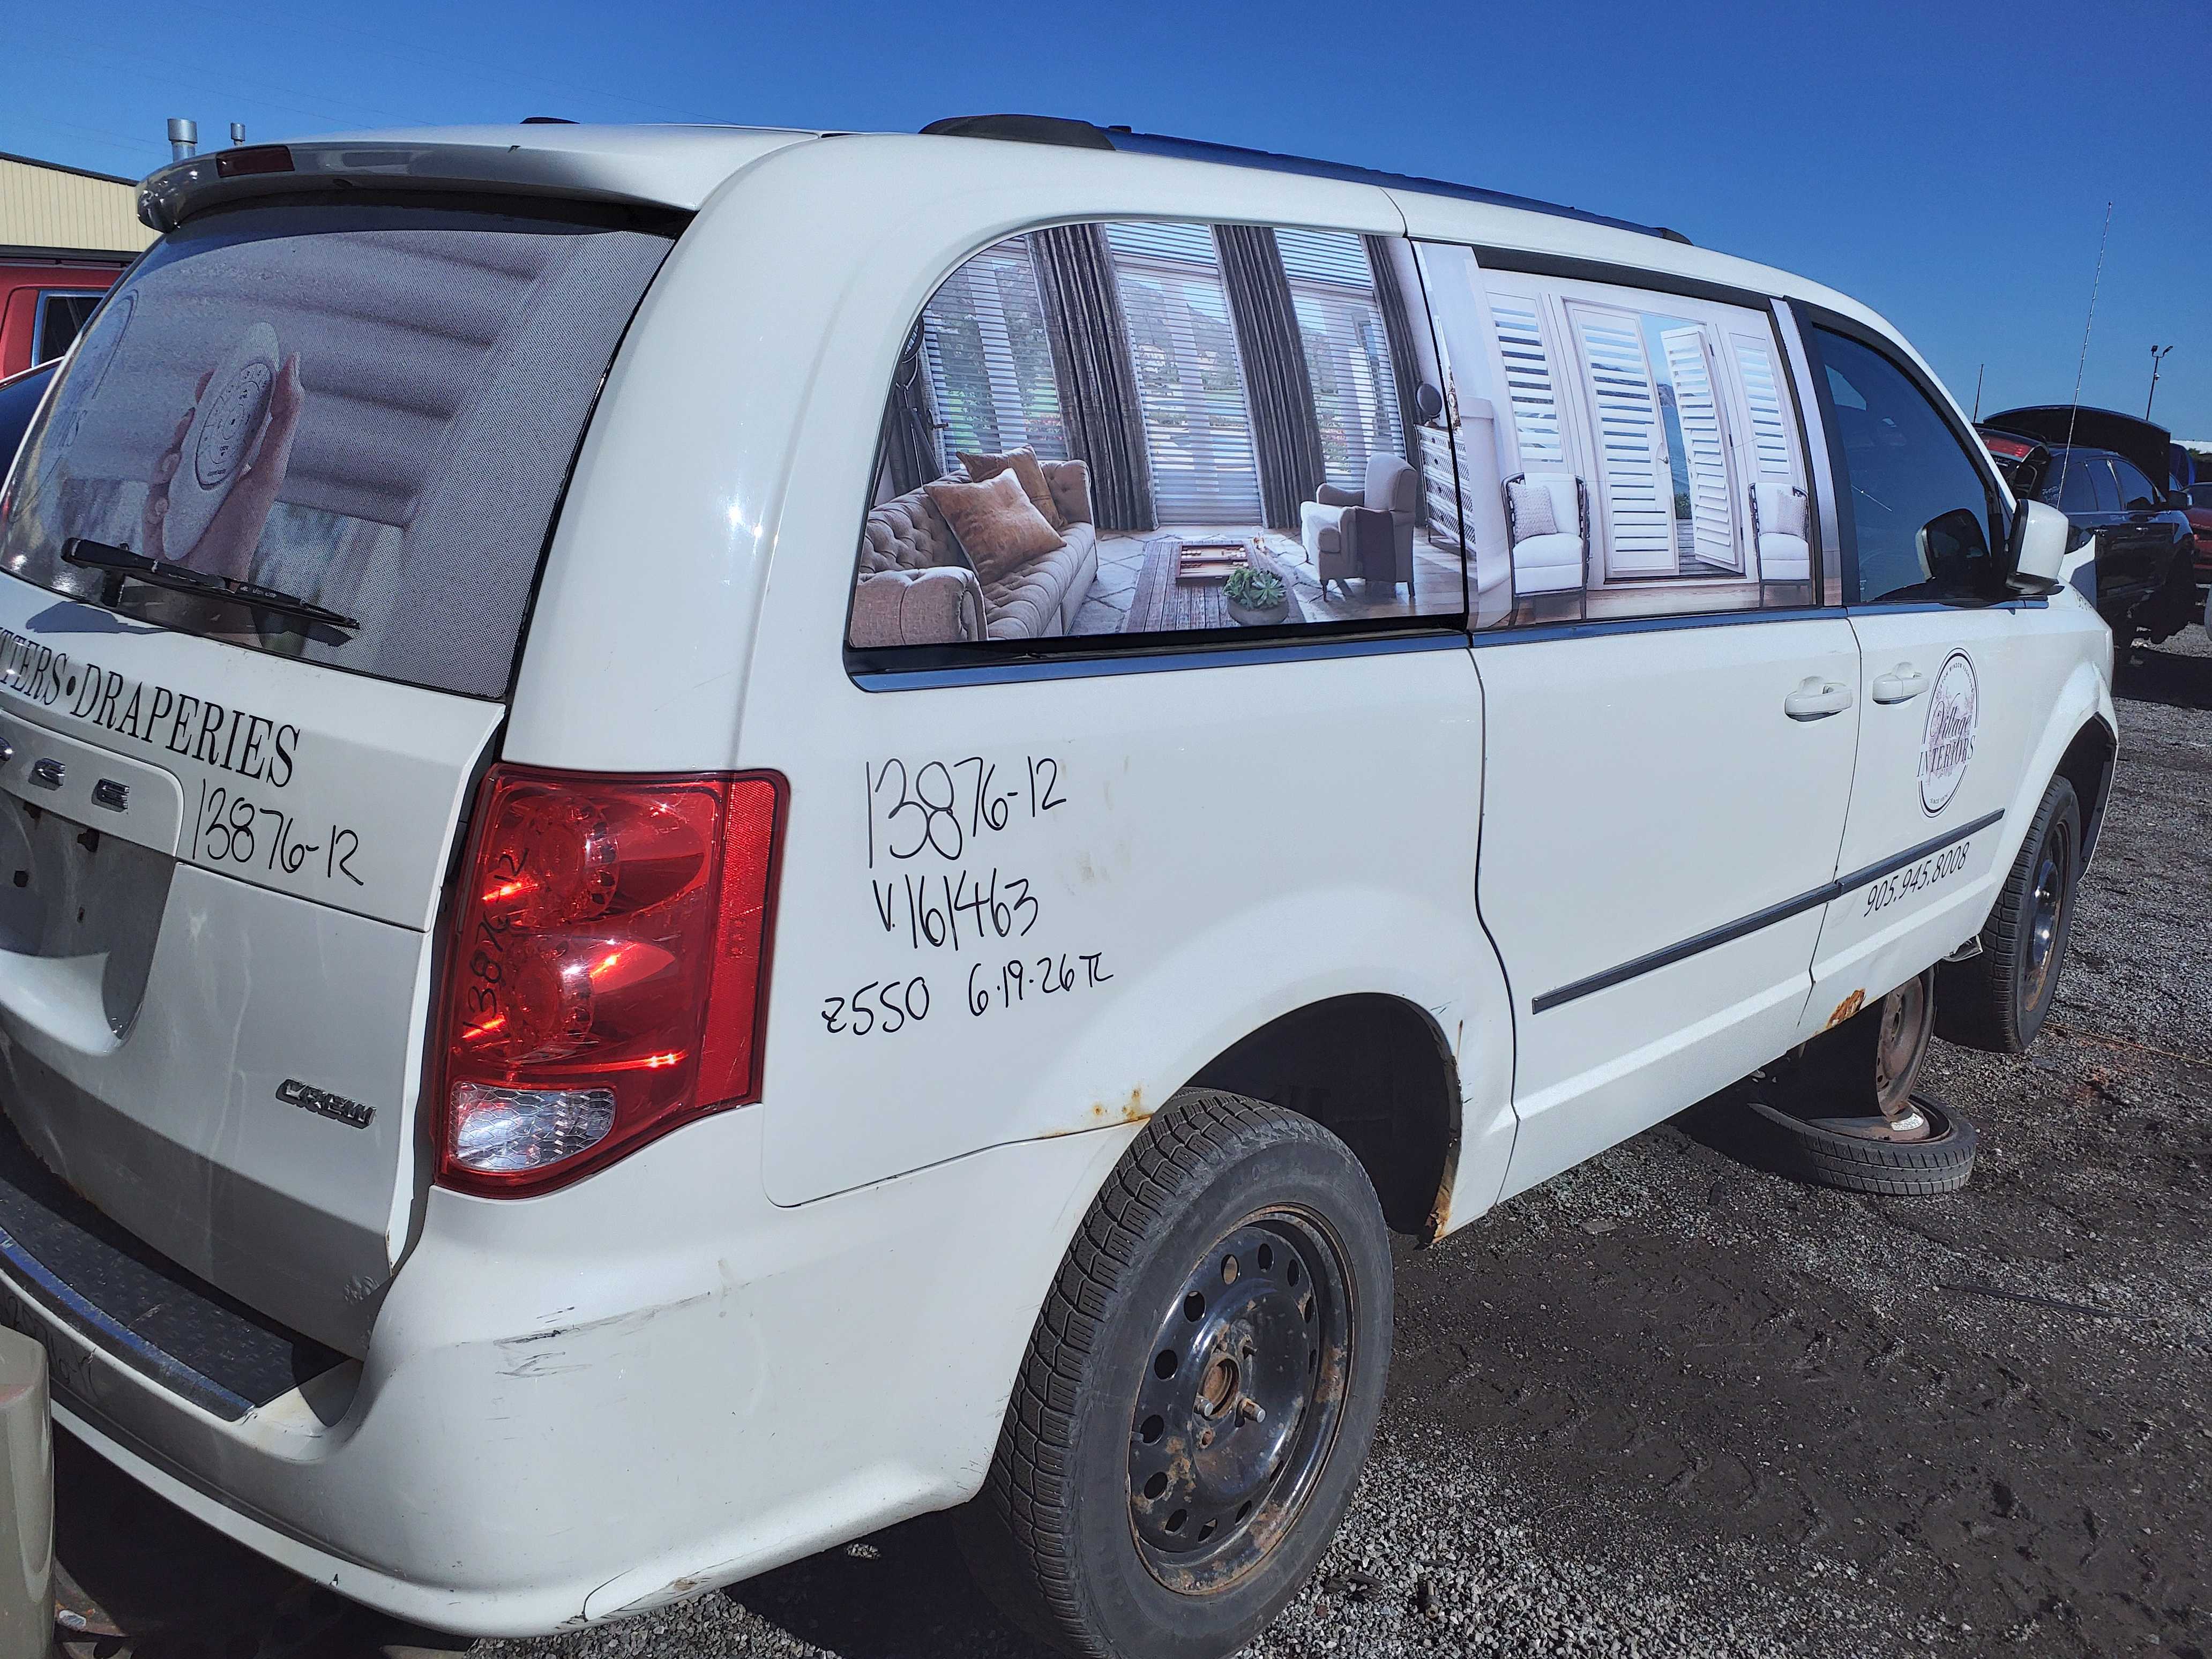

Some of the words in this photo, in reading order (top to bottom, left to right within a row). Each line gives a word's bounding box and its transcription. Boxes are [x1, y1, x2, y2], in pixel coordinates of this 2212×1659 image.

[0, 626, 70, 705] TTERS
[70, 663, 302, 788] DRAPERIES
[1930, 693, 1972, 745] Village
[1916, 735, 1976, 778] INTERIORS
[866, 756, 1066, 869] 13876-12
[1864, 841, 1970, 918] 905.945.8008
